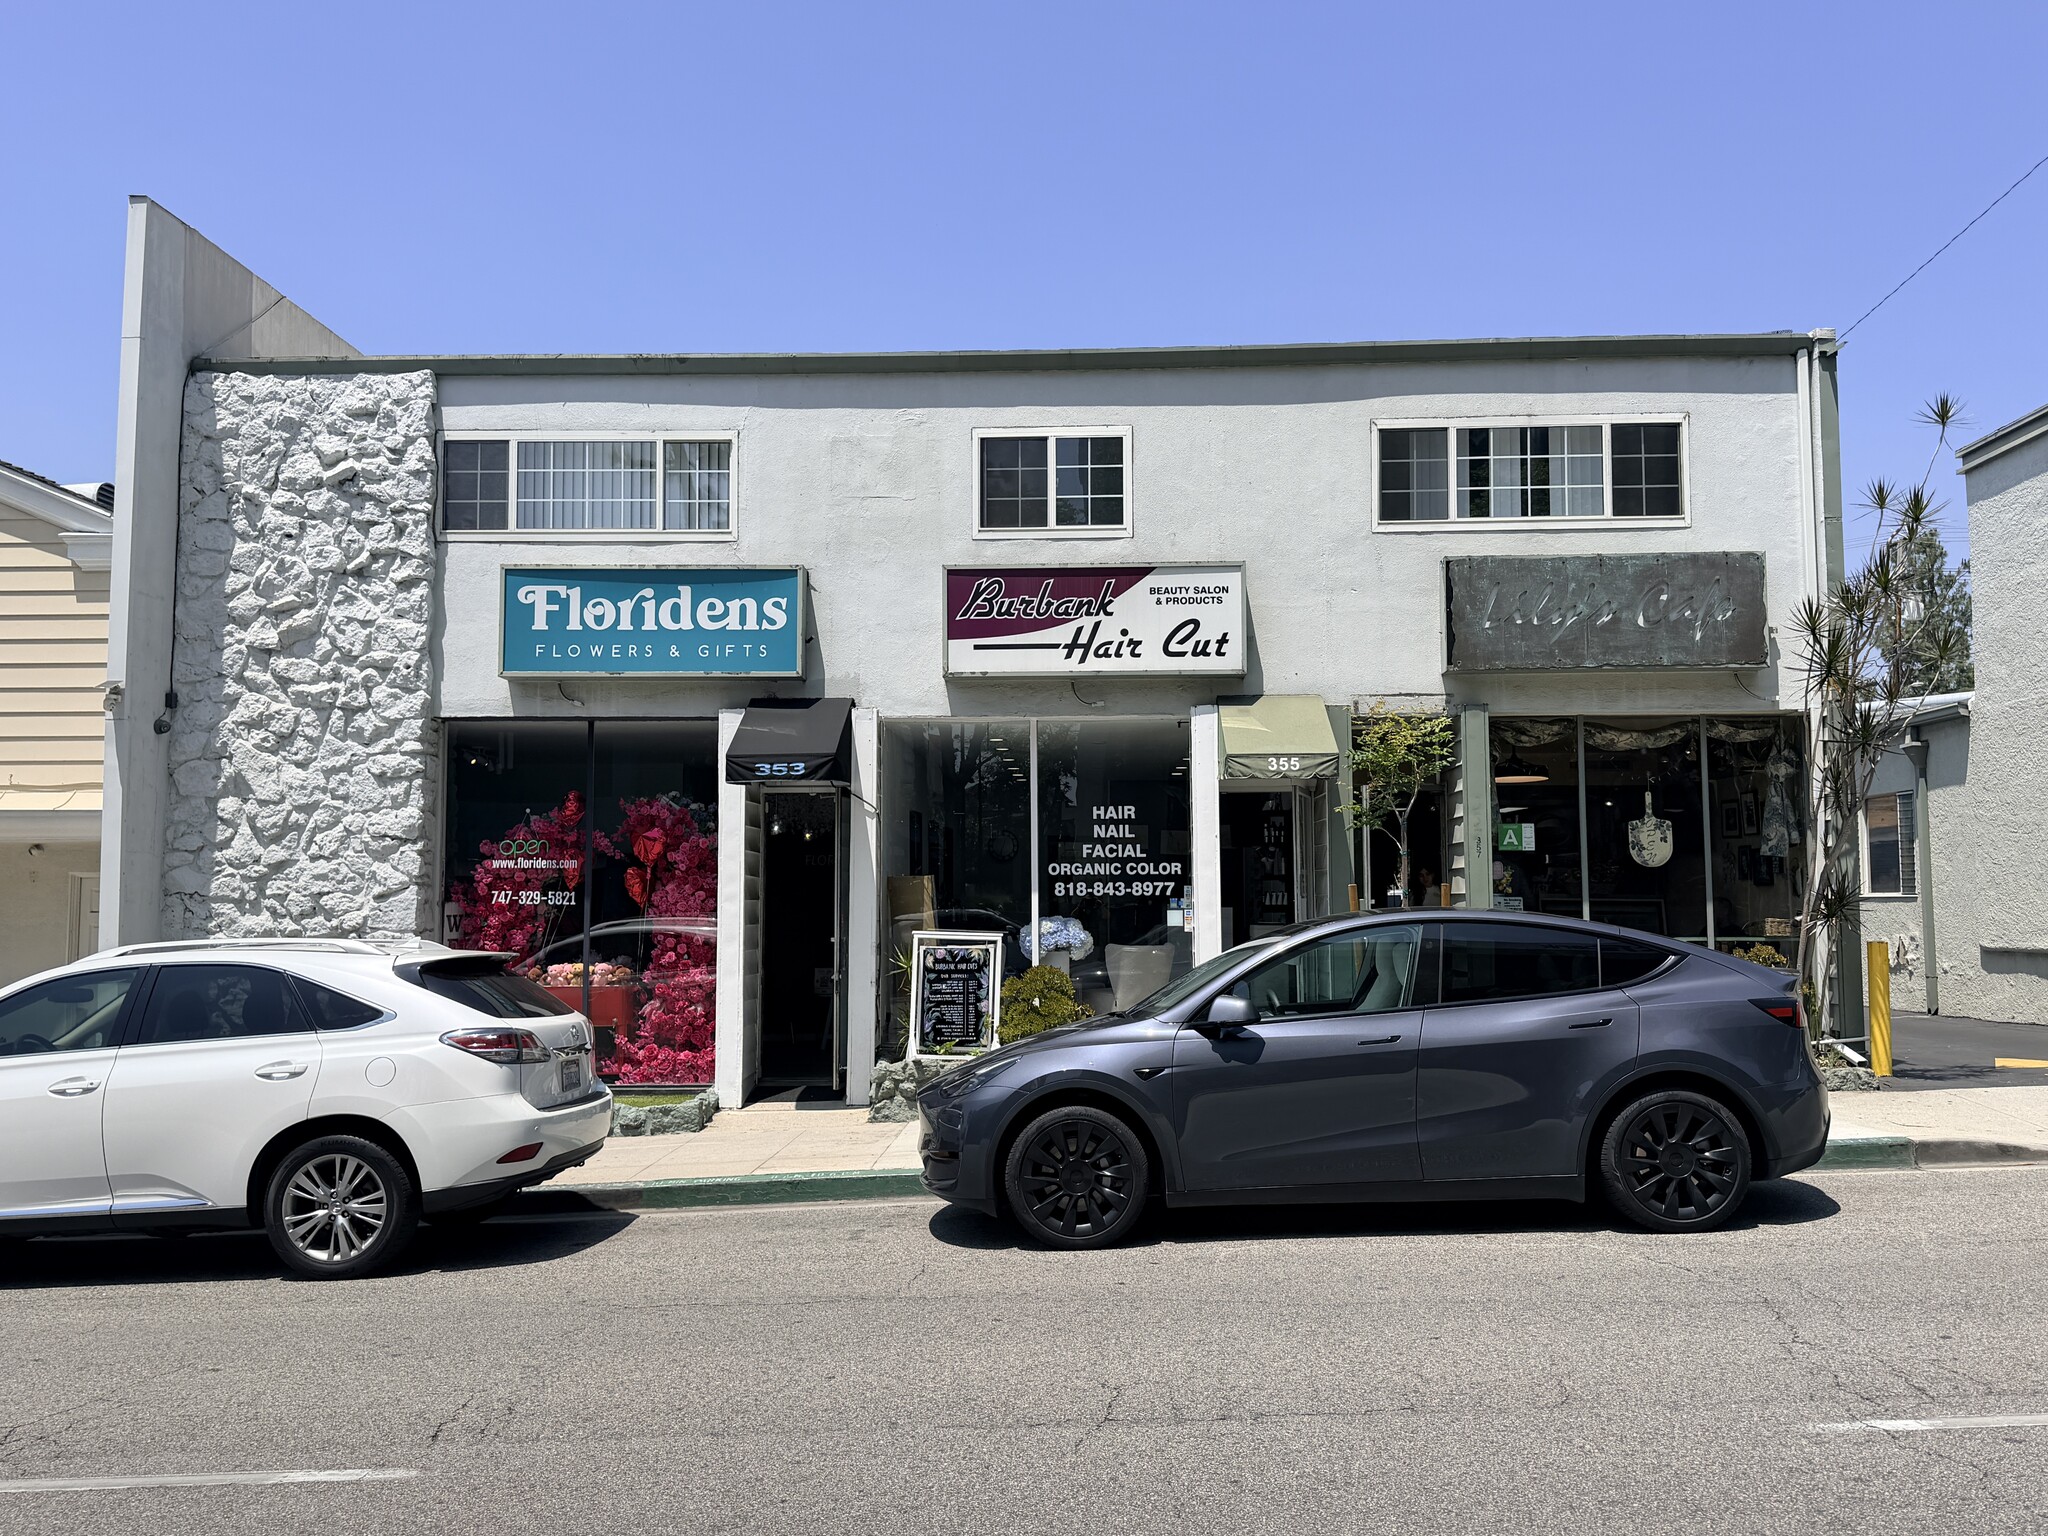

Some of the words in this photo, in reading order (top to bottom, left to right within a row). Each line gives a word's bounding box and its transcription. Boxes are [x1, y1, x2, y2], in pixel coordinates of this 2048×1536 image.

[1149, 586, 1191, 595] BEAUTY
[1193, 586, 1229, 595] SALON
[955, 577, 1116, 621] Burbank
[1155, 597, 1163, 606] &
[1165, 596, 1223, 606] PRODUCTS
[517, 585, 788, 631] Floridens
[1061, 620, 1144, 665] Hair
[1162, 618, 1229, 658] Cut
[535, 644, 654, 658] FLOWERS
[669, 644, 681, 658] &
[698, 644, 768, 658] GIFTS
[754, 761, 806, 777] 353
[1267, 757, 1300, 771] 355
[1092, 805, 1136, 820] HAIR
[1093, 824, 1136, 839] NAIL
[1502, 829, 1519, 846] A
[1082, 844, 1147, 858] FACIAL
[492, 856, 578, 870] www.floridens.com
[1048, 863, 1122, 876] ORGANIC
[1126, 862, 1182, 876] COLOR
[1054, 882, 1175, 897] 818-843-8977
[491, 890, 576, 906] 747-329-5821
